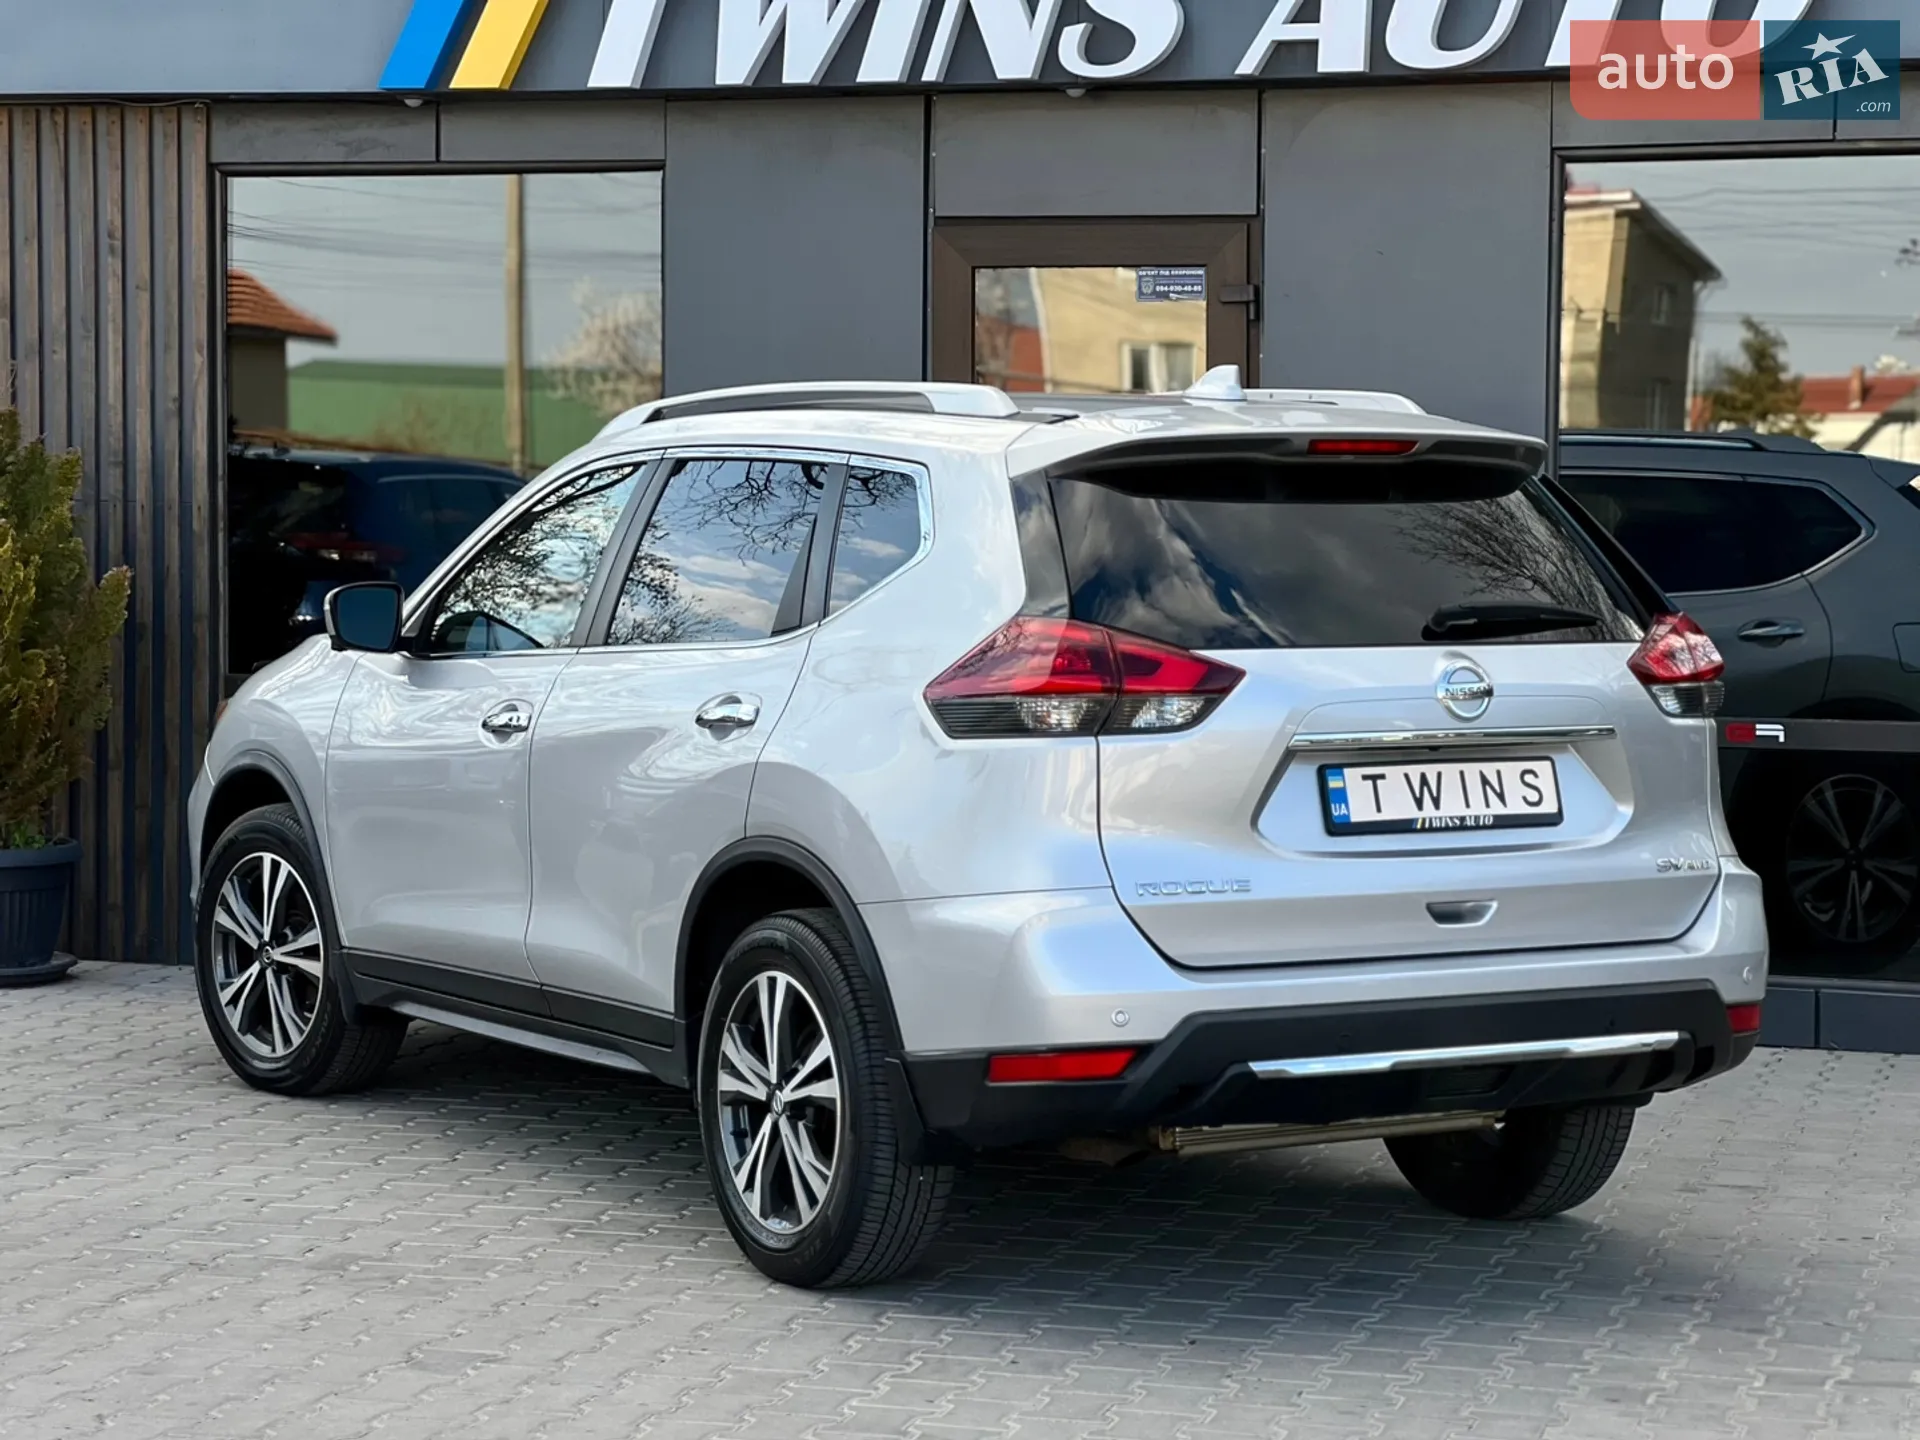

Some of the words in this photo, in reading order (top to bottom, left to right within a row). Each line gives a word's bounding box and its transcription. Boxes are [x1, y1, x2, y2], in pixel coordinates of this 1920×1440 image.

[1445, 683, 1493, 696] NISSAN
[1361, 768, 1543, 813] TWINS
[1331, 803, 1348, 815] UA
[1135, 878, 1252, 896] ROGUE
